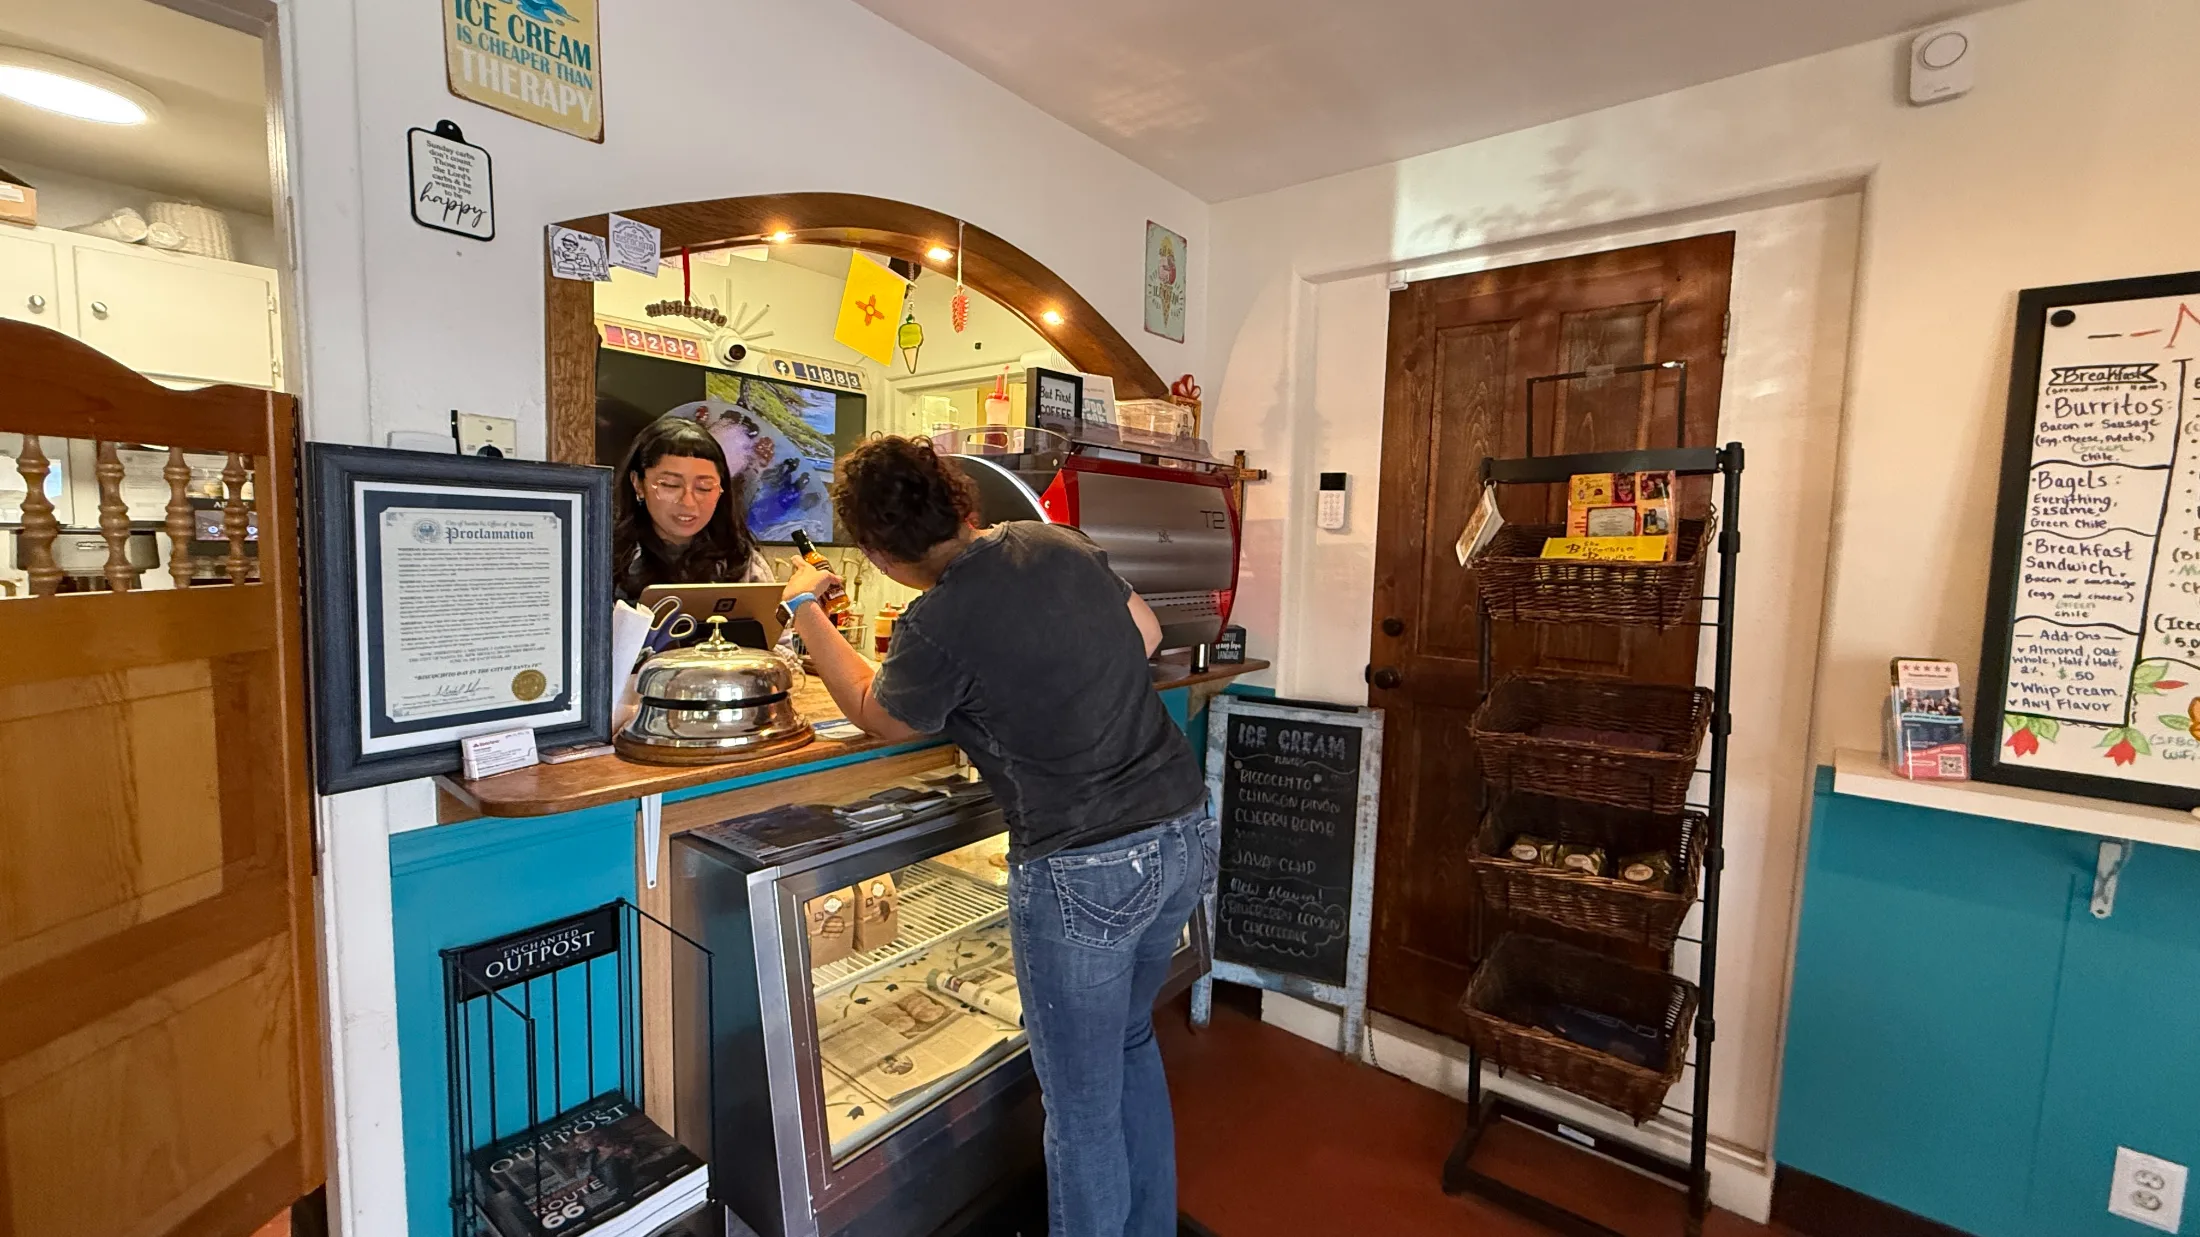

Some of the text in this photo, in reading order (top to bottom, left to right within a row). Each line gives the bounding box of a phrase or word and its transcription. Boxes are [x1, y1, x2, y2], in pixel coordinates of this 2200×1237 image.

[455, 0, 591, 71] ICE CREAM
[456, 23, 593, 91] IS CHEAPER THAN
[456, 44, 593, 124] THERAPY
[426, 139, 454, 155] Sunday
[432, 157, 470, 174] Those are
[433, 165, 446, 174] the
[444, 189, 452, 197] to
[420, 181, 487, 228] happy
[628, 332, 696, 357] 3232
[809, 368, 859, 387] 1883
[2063, 366, 2142, 383] Breakfast
[1040, 385, 1053, 399] But
[1040, 404, 1072, 420] COFFEE
[2040, 421, 2079, 433] Bacon
[2101, 419, 2160, 434] Sausage
[2034, 493, 2117, 512] Everything,
[2032, 506, 2101, 517] Sesame,
[2030, 518, 2070, 528] Green
[445, 527, 534, 545] Proclamation
[2035, 538, 2133, 560] Breakfast
[2025, 573, 2062, 584] Bacon
[2027, 589, 2055, 600] (egg
[2040, 629, 2102, 641] Add-Ons
[2059, 656, 2082, 666] Half
[2021, 682, 2060, 698] Whip
[2057, 699, 2112, 711] Flavor
[1238, 723, 1346, 760] ICE CREAM
[1235, 807, 1336, 837] CHERRY BOMB
[1232, 848, 1316, 875] JAVA CHIP
[503, 929, 579, 959] ENCHANTED
[485, 930, 595, 978] OUTPOST
[490, 1103, 625, 1174] OUTPOST
[542, 1202, 586, 1229] 66
